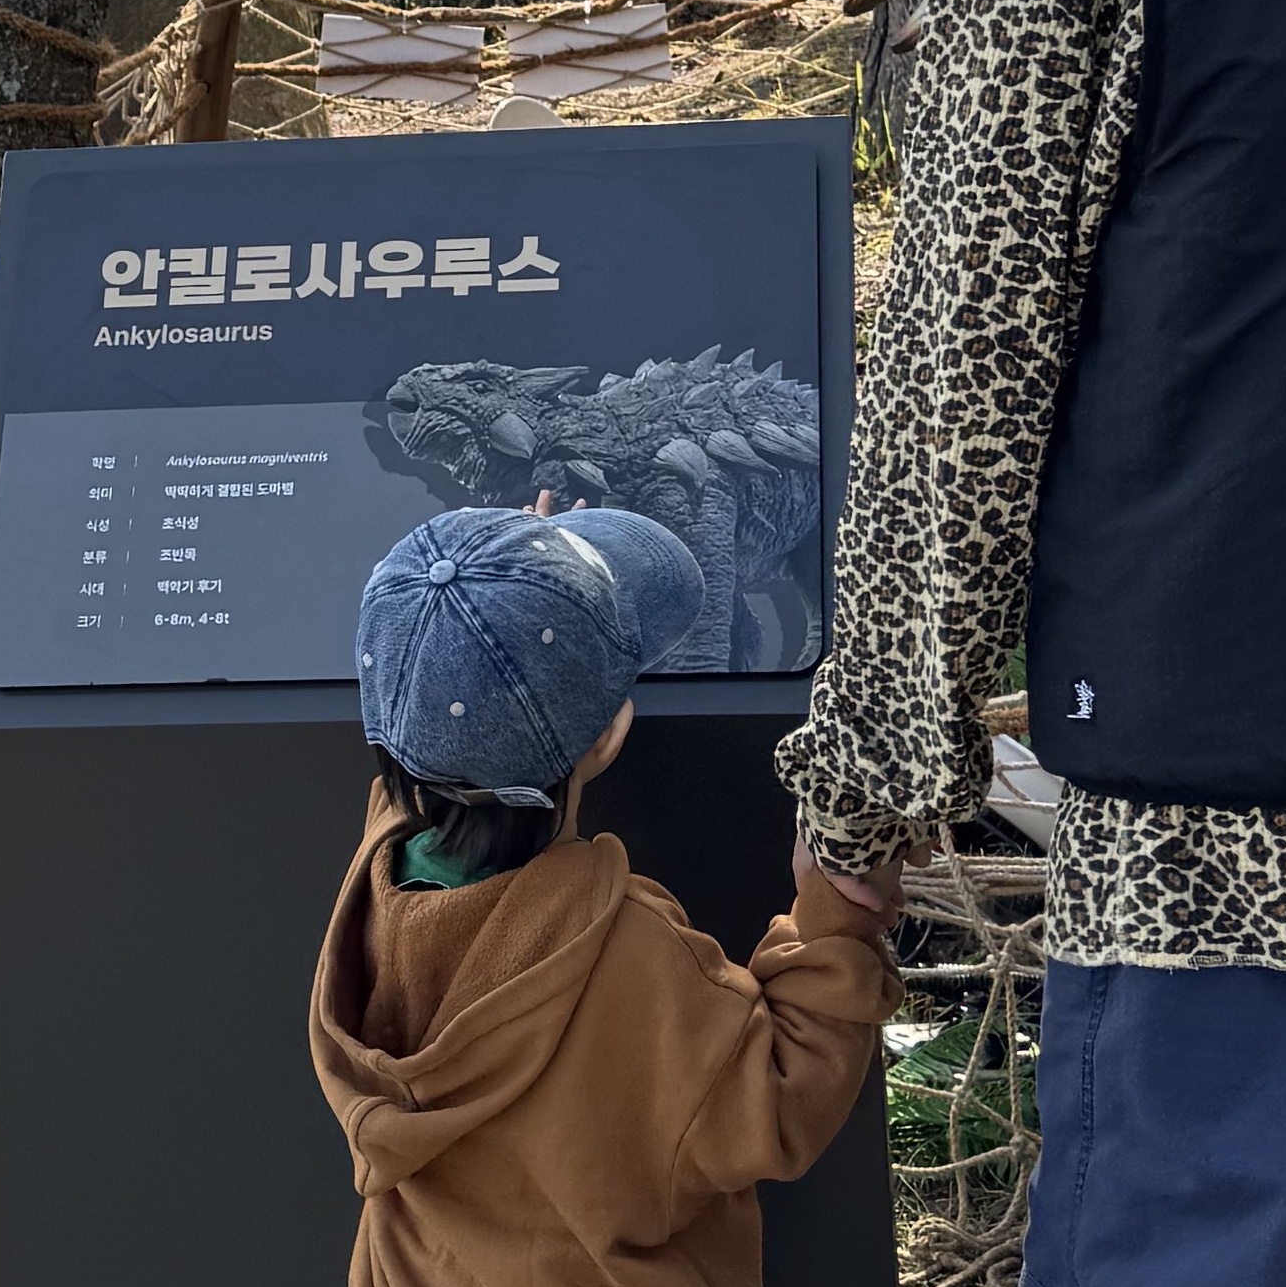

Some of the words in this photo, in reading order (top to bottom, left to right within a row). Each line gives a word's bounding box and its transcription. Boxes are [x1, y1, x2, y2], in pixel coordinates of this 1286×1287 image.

[101, 235, 561, 309] 안킬로사우루스
[94, 320, 273, 352] Ankylosaurus
[166, 454, 247, 469] Ankylosaurus
[86, 518, 110, 533] 식성
[161, 516, 200, 531] 초식성
[79, 581, 105, 597] 시대
[197, 578, 223, 594] 후기
[76, 615, 102, 629] 크기
